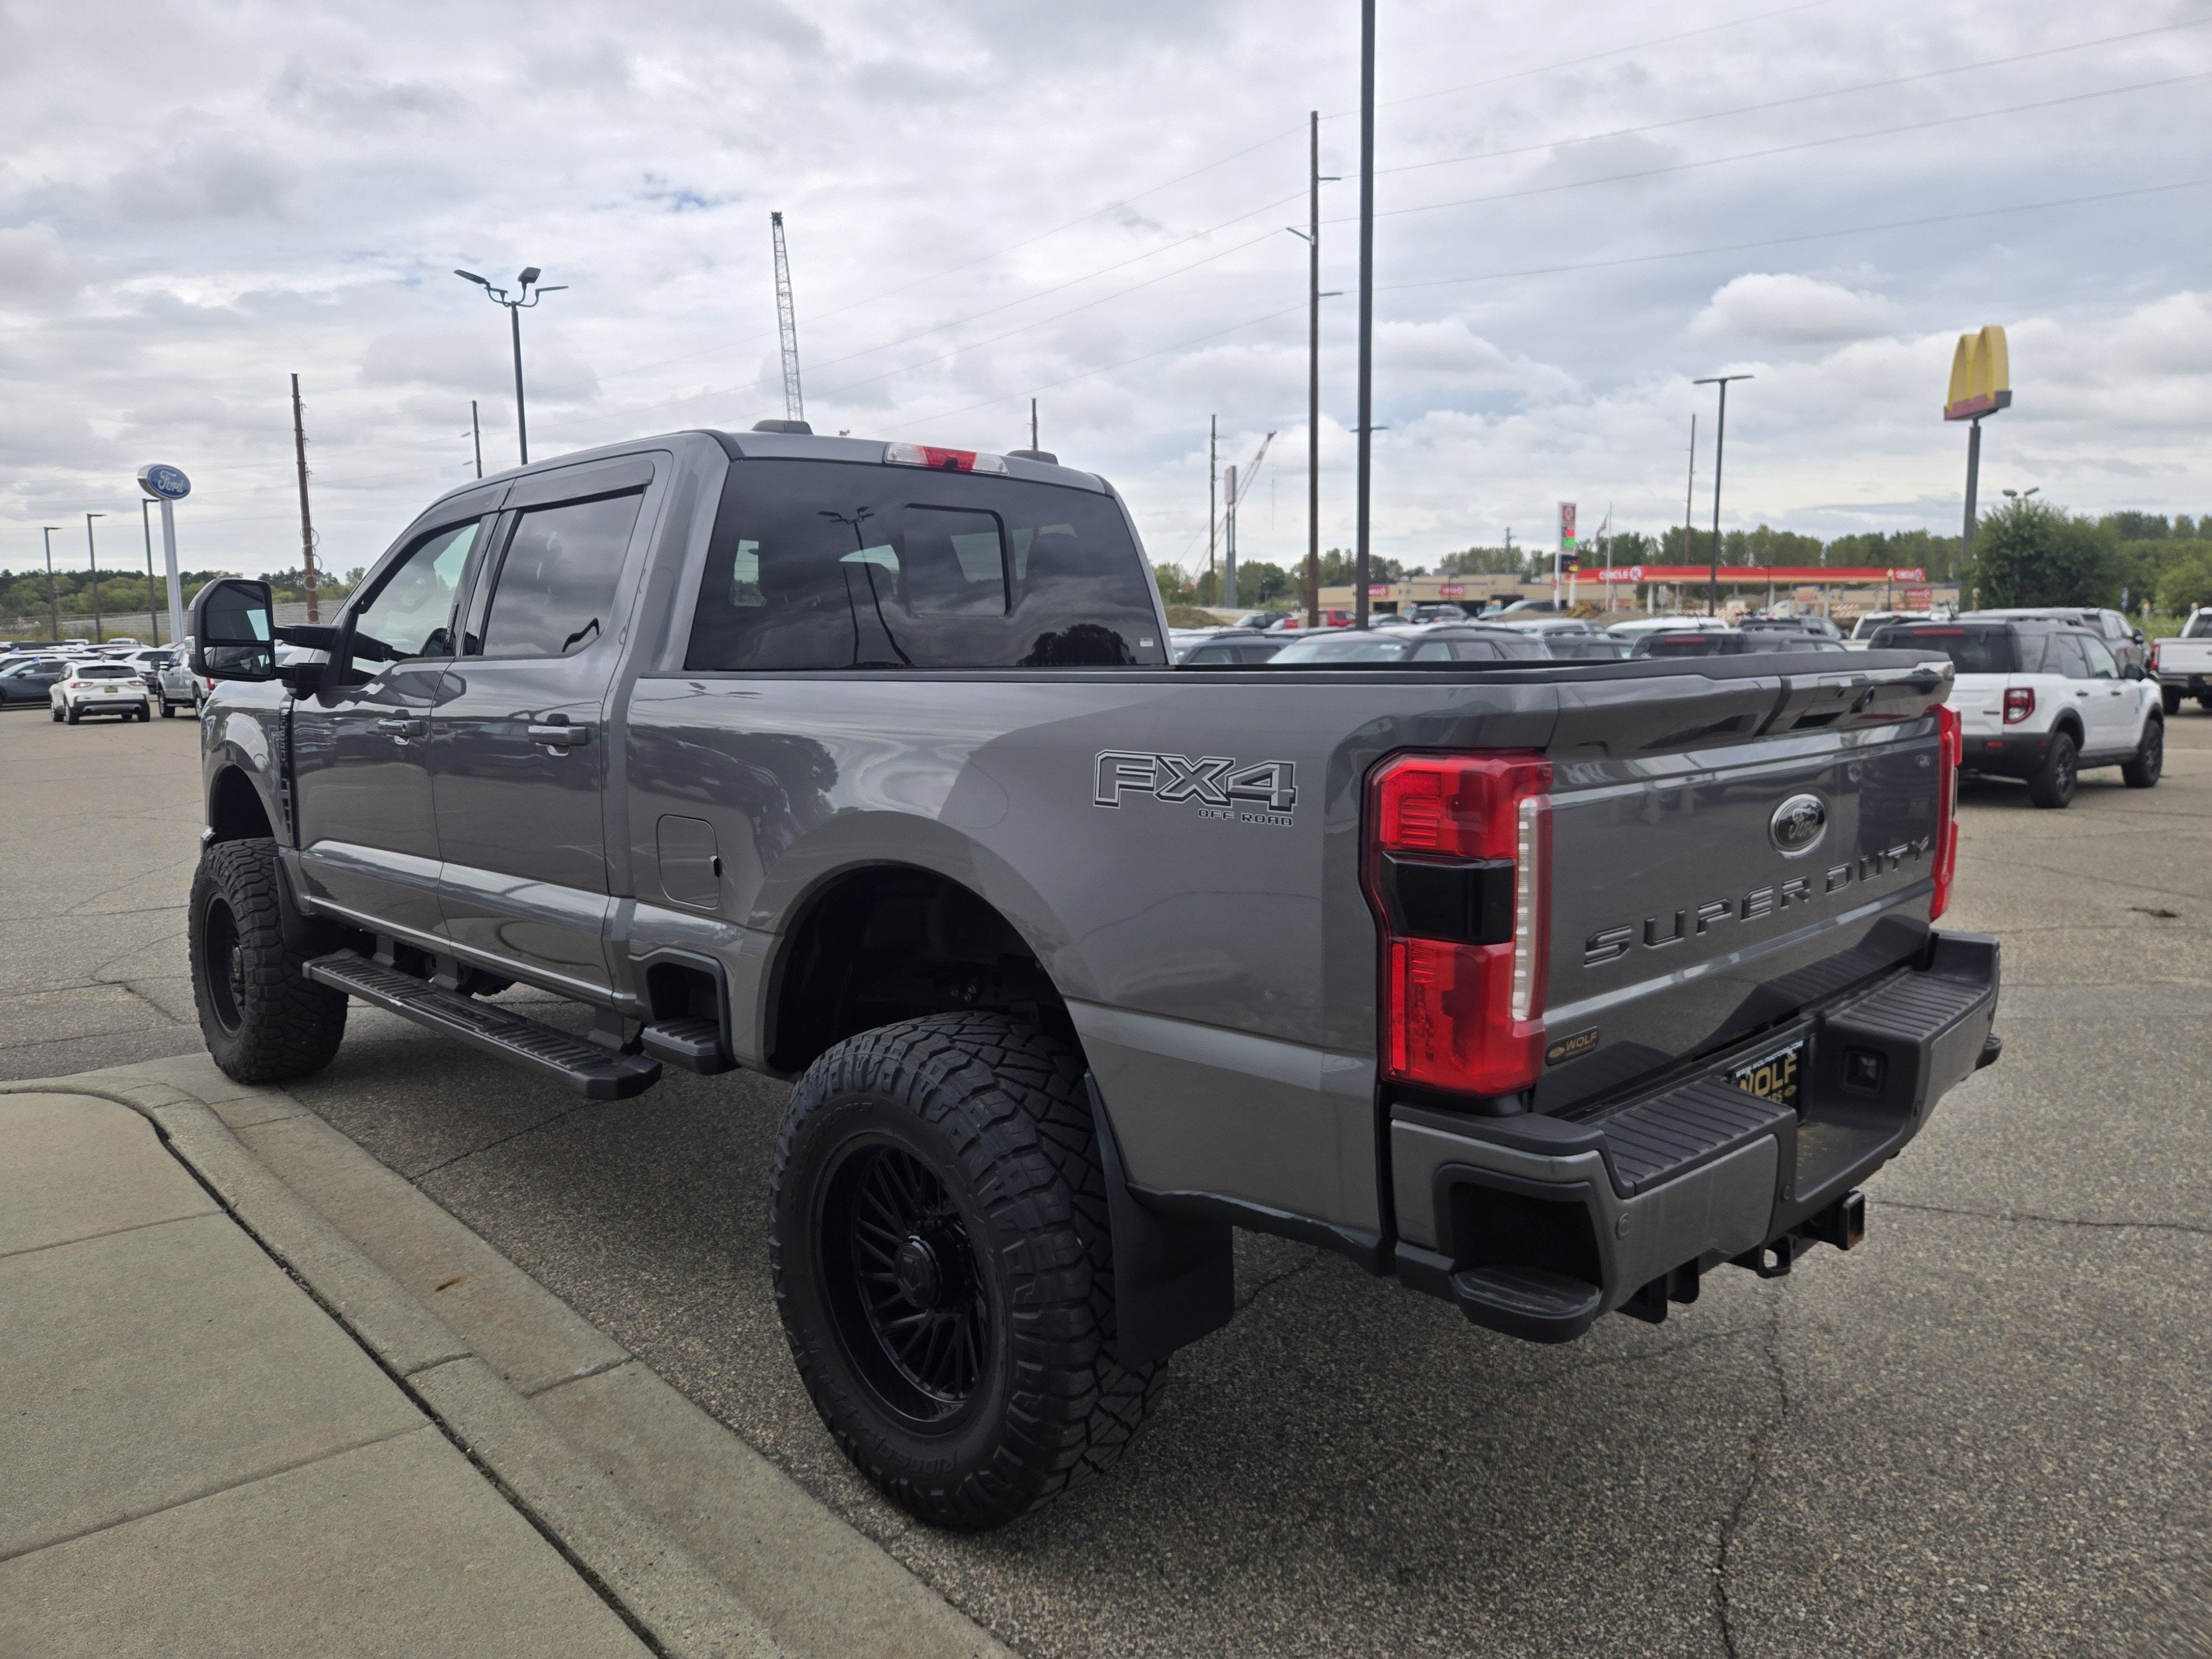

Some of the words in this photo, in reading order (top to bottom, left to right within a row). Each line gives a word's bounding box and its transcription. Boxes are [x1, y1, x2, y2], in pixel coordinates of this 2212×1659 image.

[158, 470, 184, 493] Ford
[1093, 749, 1298, 814] FX4
[1198, 808, 1234, 820] OFF
[1240, 812, 1293, 826] ROAD
[1788, 807, 1818, 840] Ford
[1584, 876, 1811, 968] SUPER
[1825, 836, 1929, 895] DUTY
[1566, 1031, 1598, 1051] WOLF
